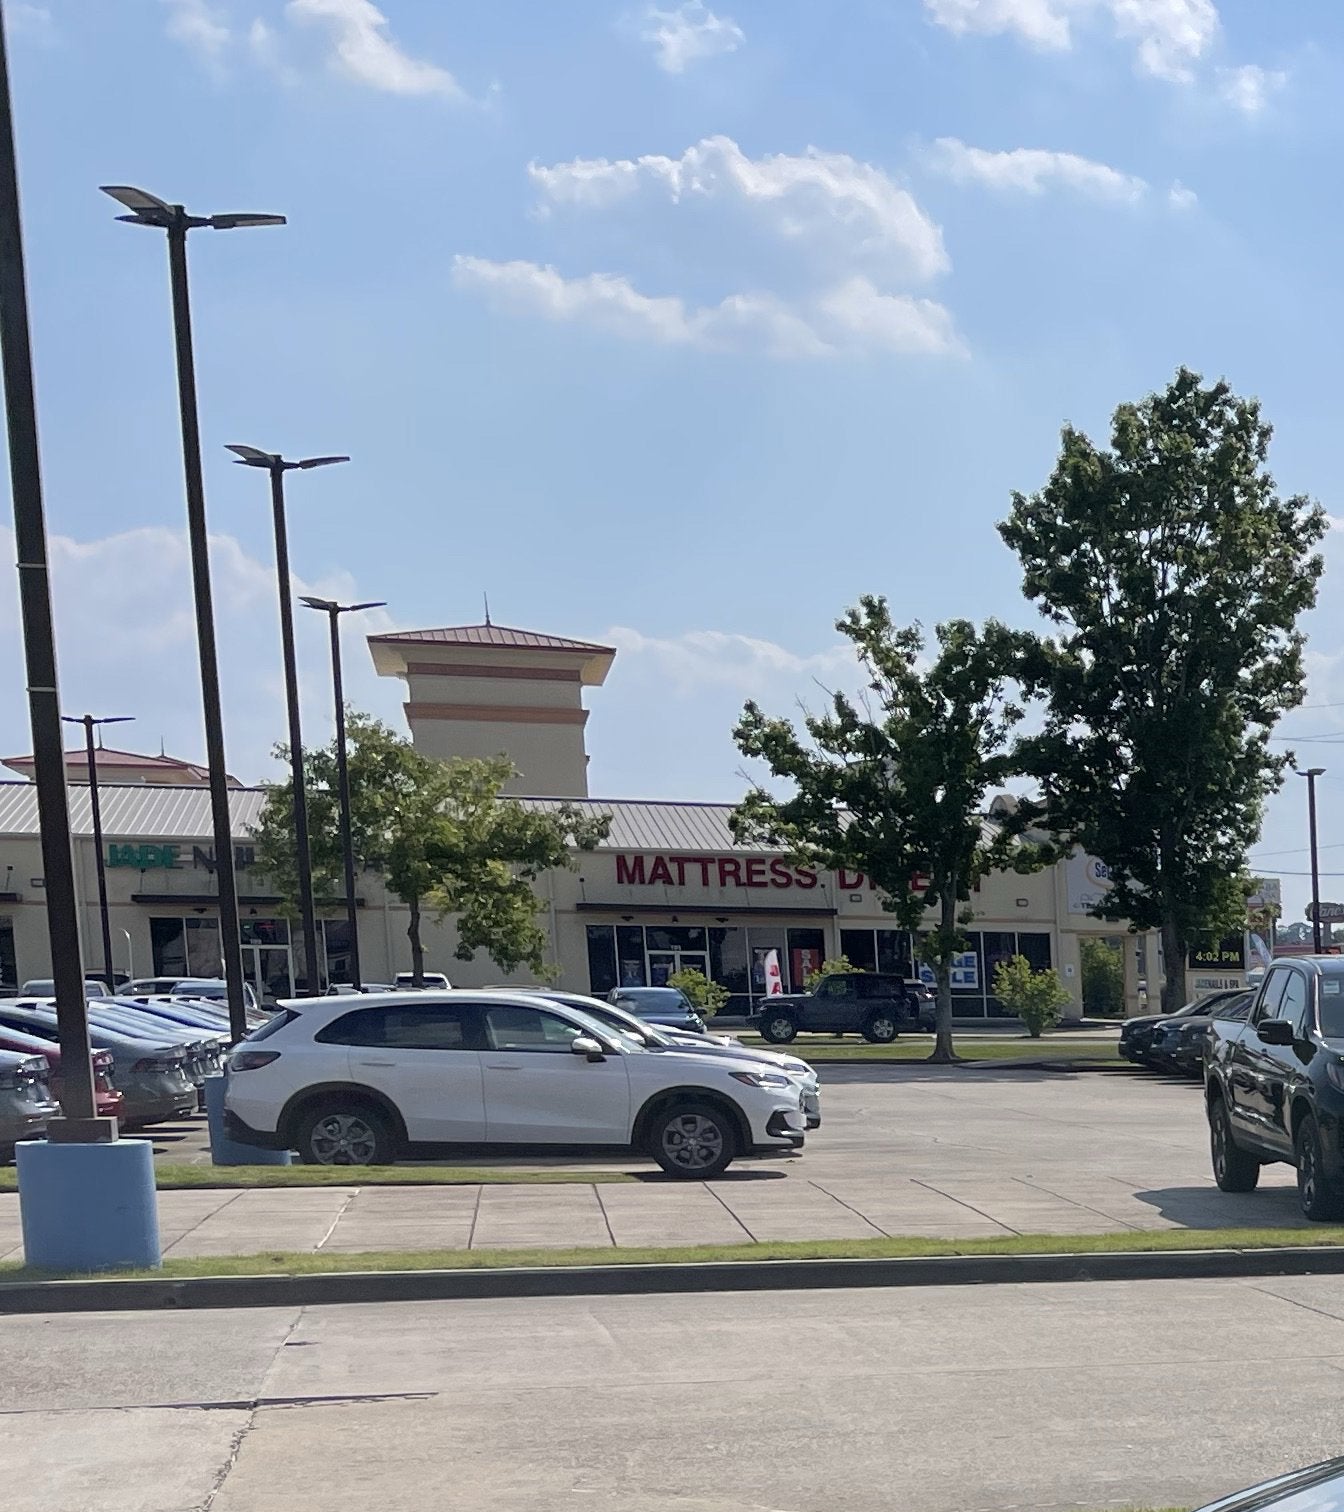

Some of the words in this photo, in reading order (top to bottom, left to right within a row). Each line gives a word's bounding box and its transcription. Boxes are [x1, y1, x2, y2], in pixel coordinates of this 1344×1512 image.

[616, 855, 818, 889] MATTRESS
[1195, 951, 1219, 962] 4:02
[1221, 951, 1240, 962] PM
[920, 970, 976, 983] SLE
